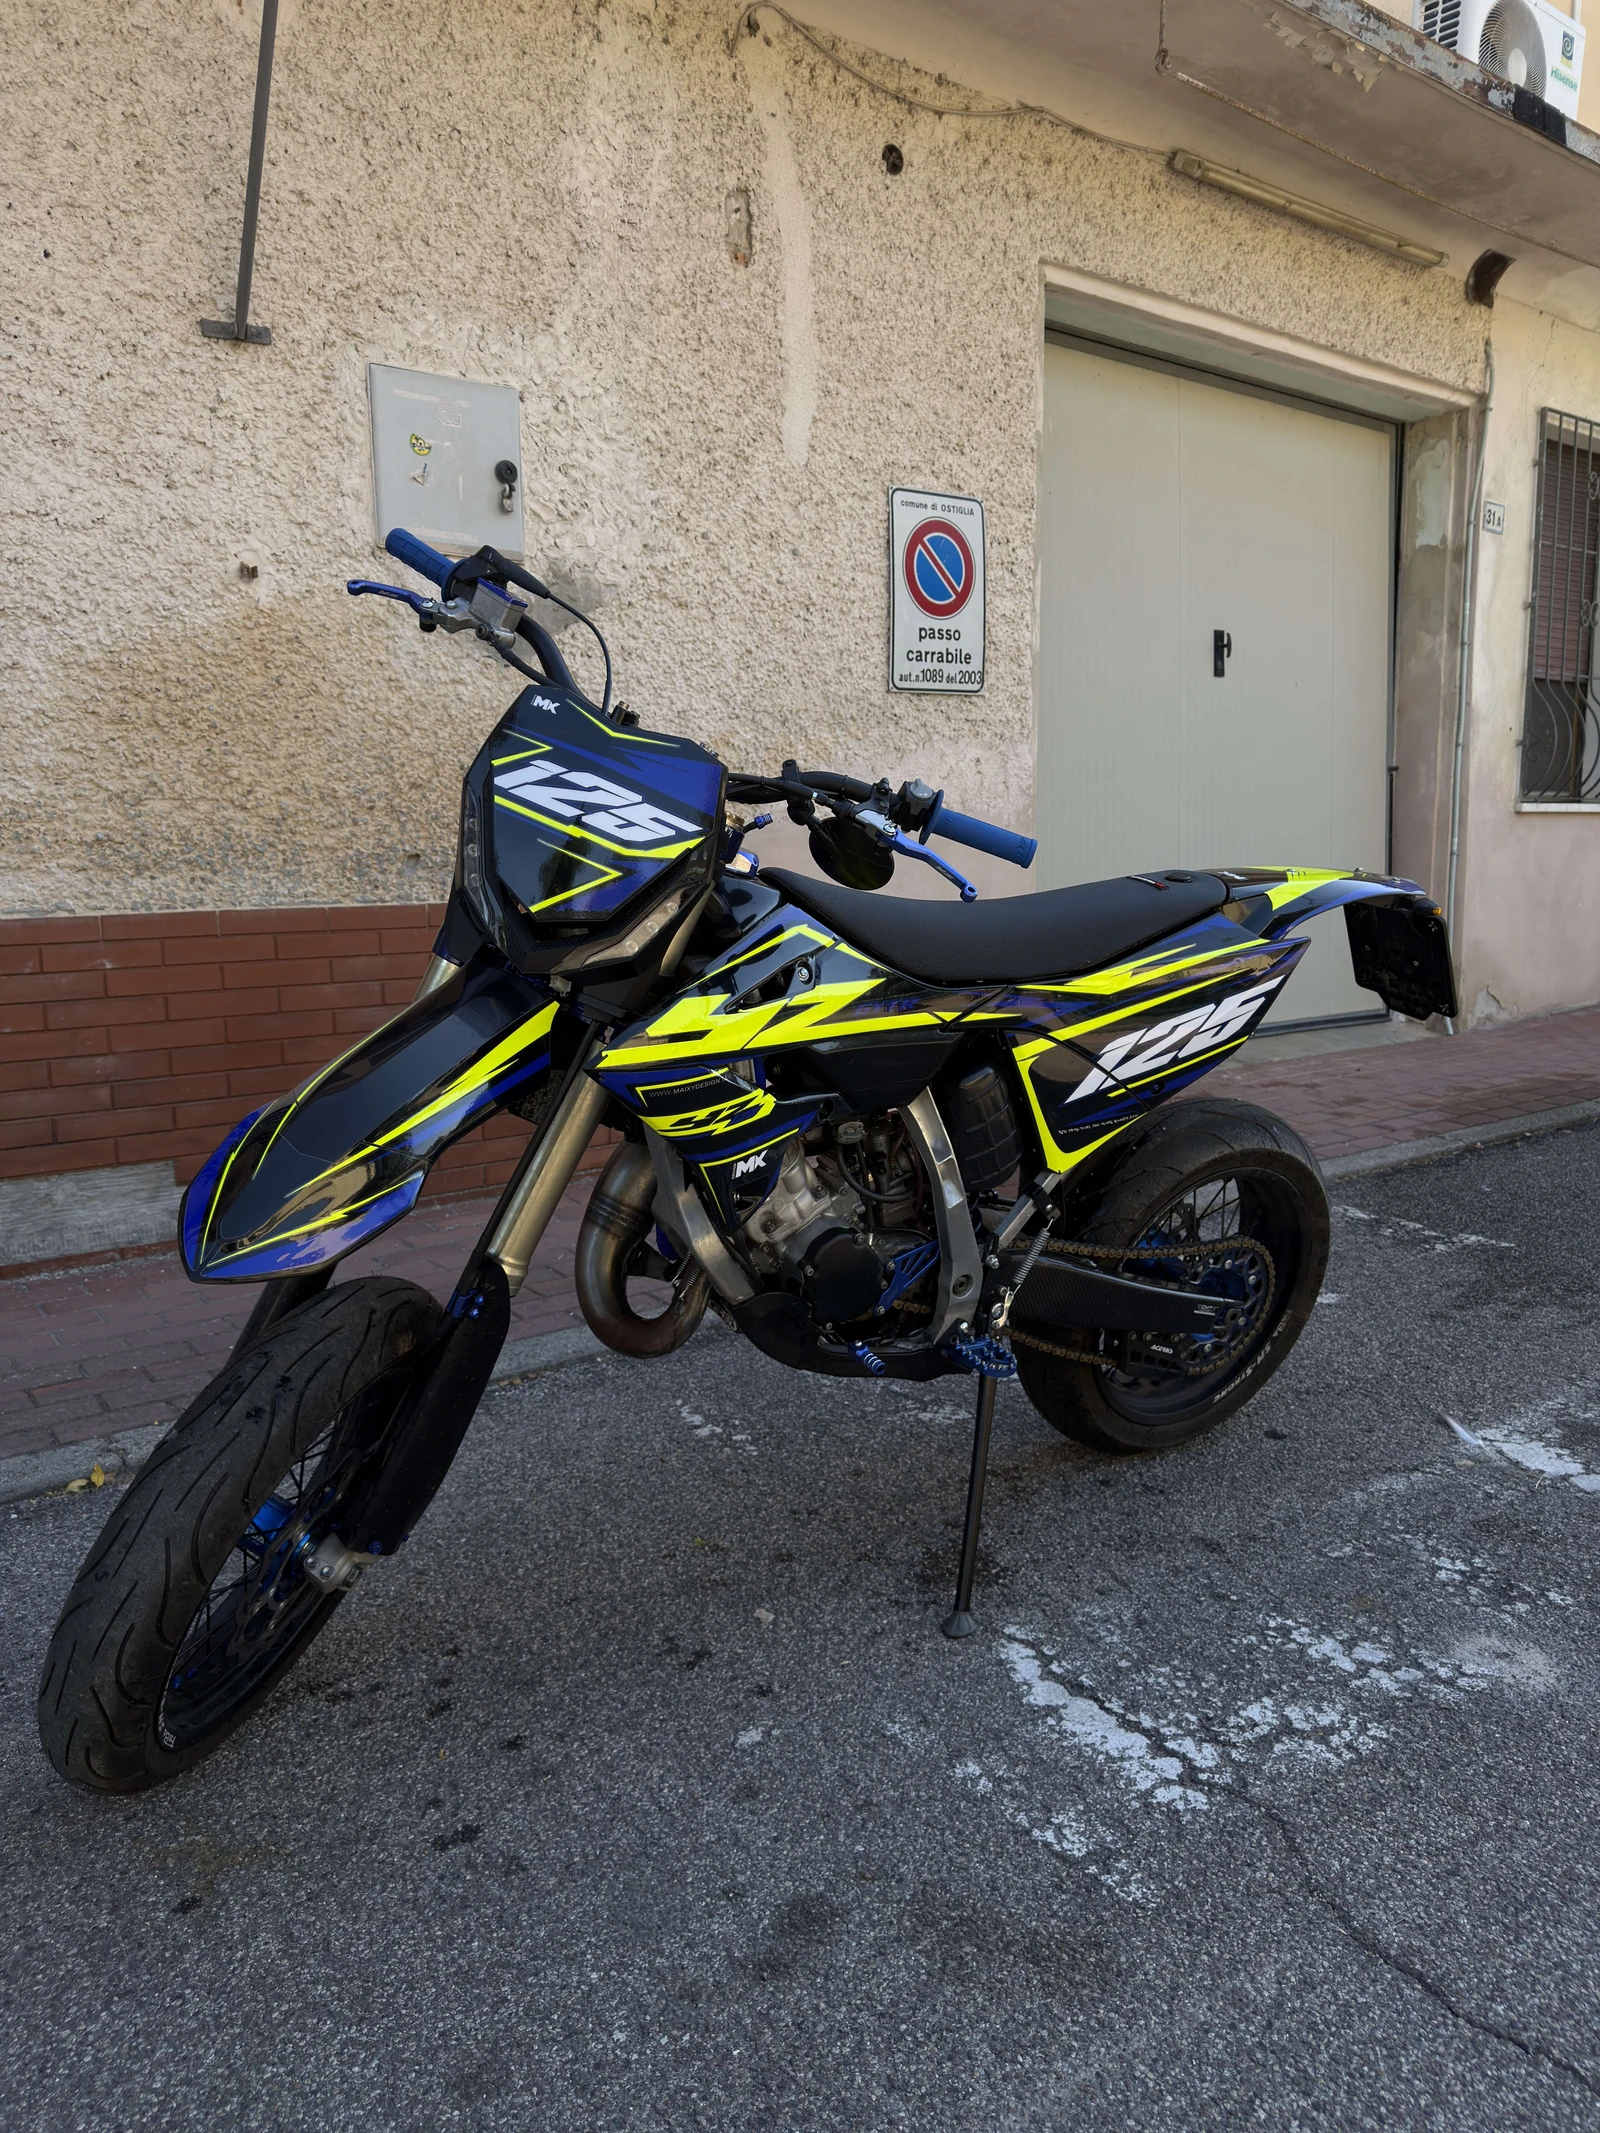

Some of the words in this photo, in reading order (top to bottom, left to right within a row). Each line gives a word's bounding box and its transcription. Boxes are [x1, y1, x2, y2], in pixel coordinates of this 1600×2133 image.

[1551, 66, 1578, 91] Hisense
[901, 500, 928, 509] comune
[931, 503, 938, 511] di
[941, 504, 975, 516] OSTIGLIA
[918, 627, 961, 642] passo
[906, 648, 972, 664] carrabile
[946, 673, 958, 684] del
[958, 670, 983, 685] 2003
[532, 695, 561, 714] MX
[494, 759, 703, 842] 125
[1064, 975, 1286, 1105] 125
[735, 1149, 769, 1178] MX
